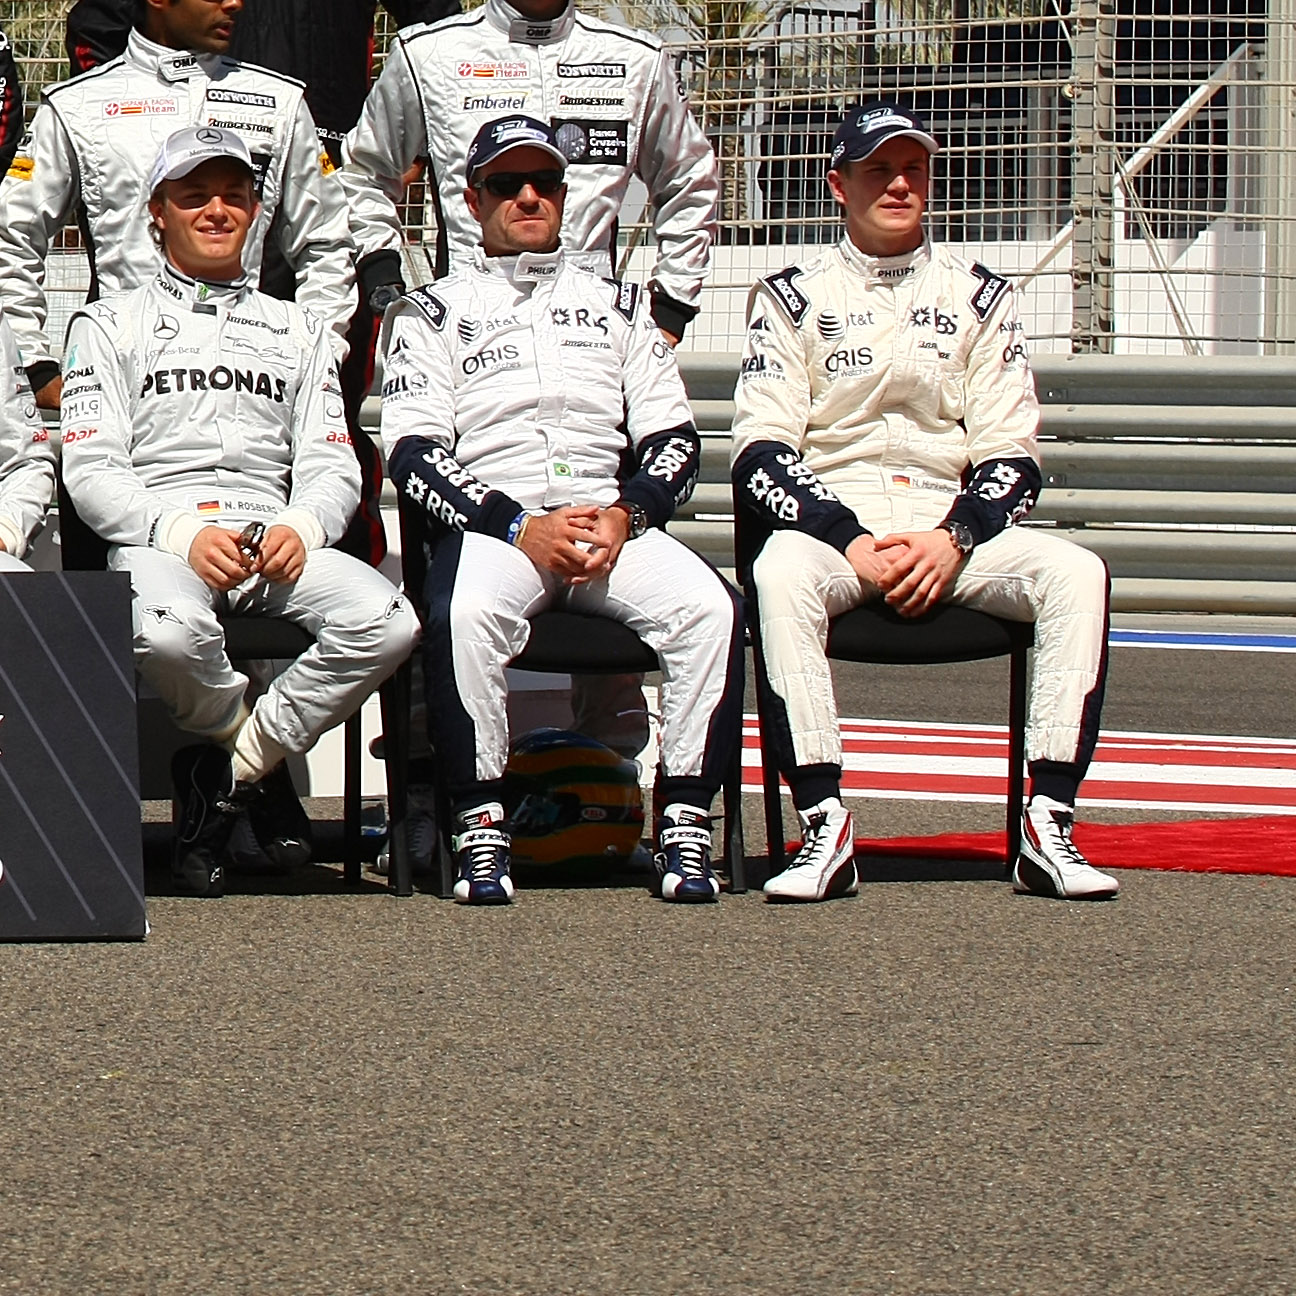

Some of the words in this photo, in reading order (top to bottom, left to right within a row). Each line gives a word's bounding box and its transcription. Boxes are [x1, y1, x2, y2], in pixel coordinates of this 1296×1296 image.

[526, 28, 551, 38] OMP
[559, 64, 624, 77] COSWORTH
[209, 90, 274, 107] COSWORTH
[463, 95, 526, 112] Embratel
[878, 267, 915, 278] PHILIPS
[576, 307, 608, 336] RS
[847, 311, 874, 326] t&t
[463, 344, 520, 375] ORIS
[143, 365, 287, 403] PETRONAS
